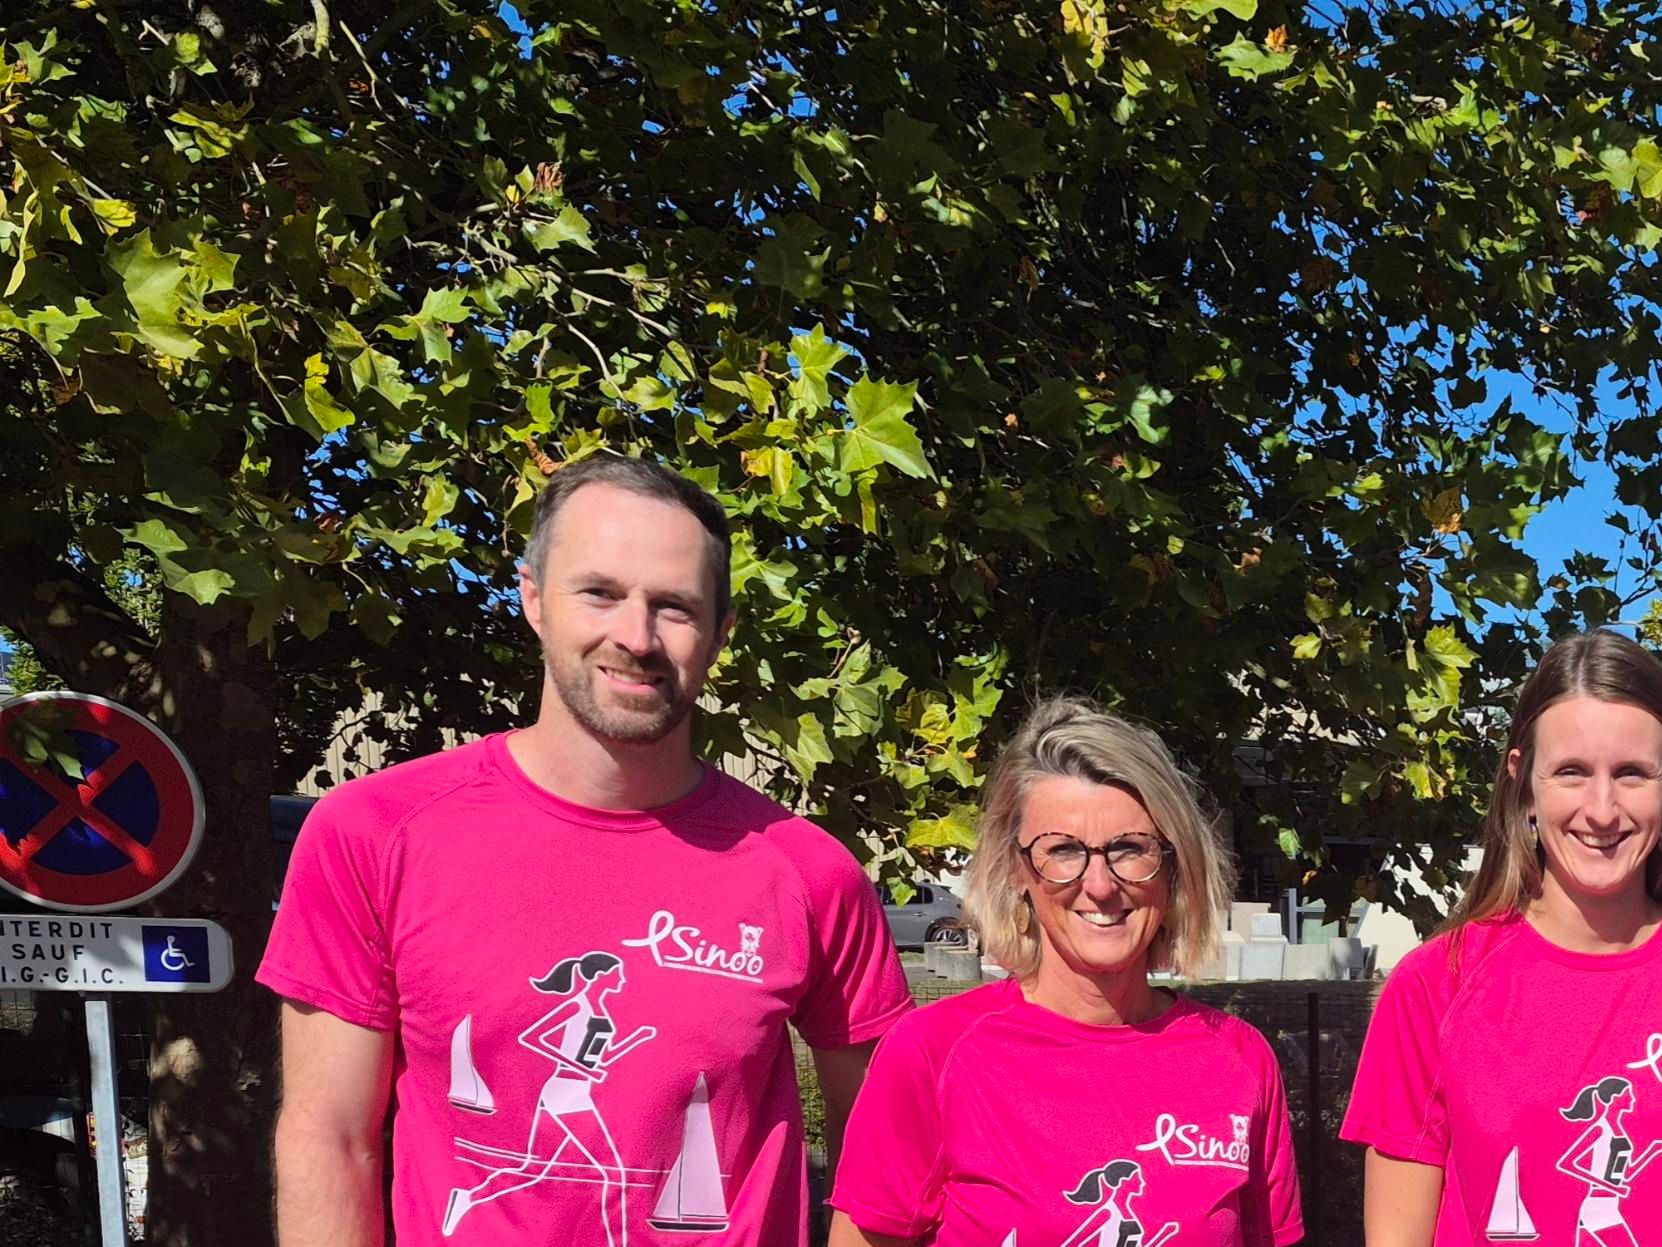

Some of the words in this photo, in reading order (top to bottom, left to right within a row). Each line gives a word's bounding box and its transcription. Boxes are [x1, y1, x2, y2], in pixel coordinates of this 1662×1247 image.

[12, 943, 84, 960] SAUF
[665, 926, 764, 976] Sinoo
[1175, 1123, 1250, 1163] Sinoo
